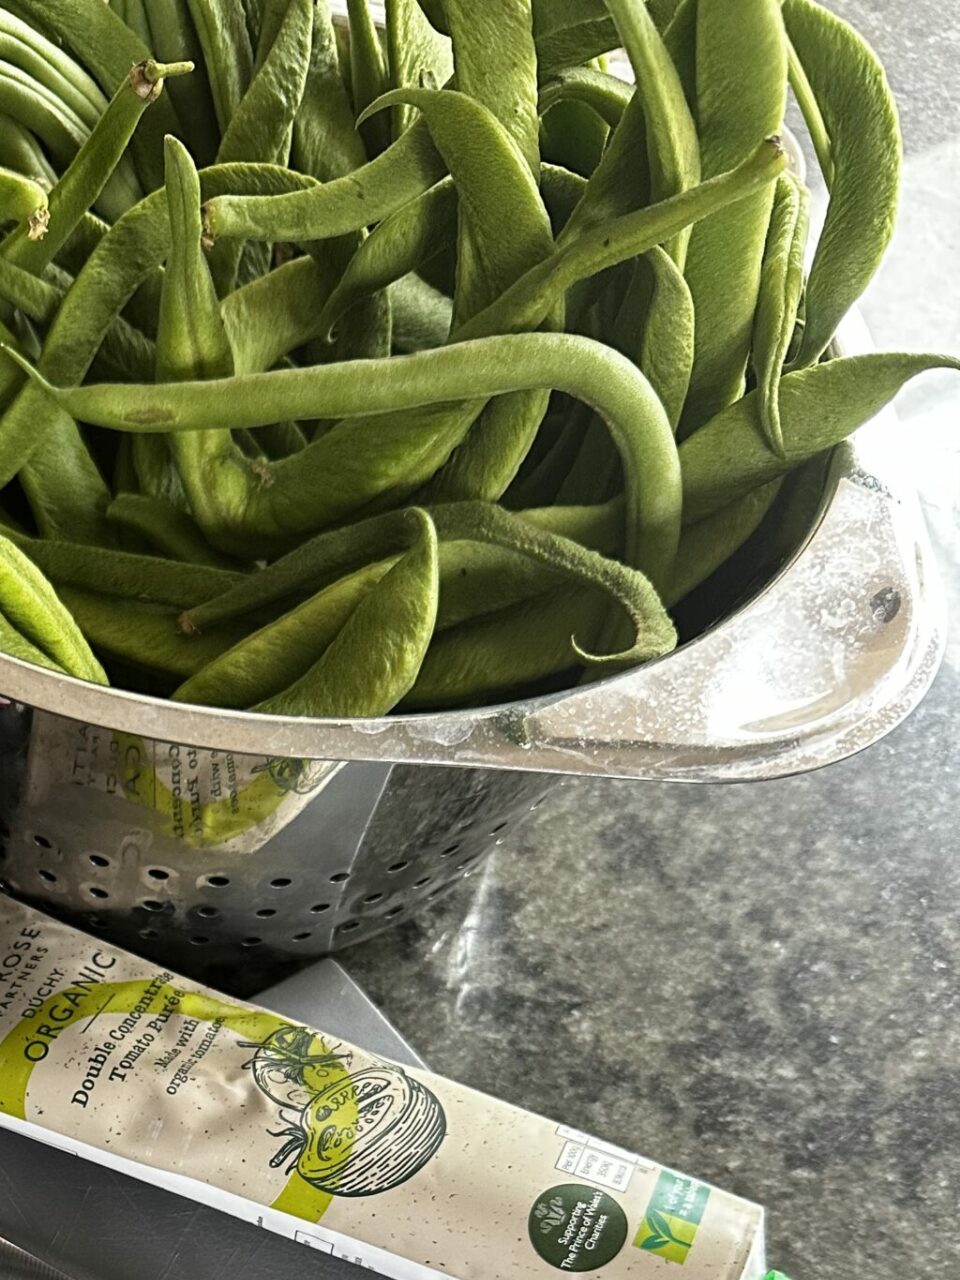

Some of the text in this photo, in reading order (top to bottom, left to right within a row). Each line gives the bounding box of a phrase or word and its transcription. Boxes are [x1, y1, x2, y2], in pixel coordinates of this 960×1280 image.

[22, 967, 65, 1019] DUCHY
[24, 951, 117, 1062] ORGANIC
[108, 989, 186, 1083] Tomato Purée
[153, 1018, 200, 1070] Made with
[71, 1041, 115, 1108] Double
[166, 1057, 195, 1096] organic
[558, 1200, 587, 1247] Supporting
[560, 1249, 576, 1270] The
[569, 1224, 587, 1253] Prince
[583, 1212, 593, 1227] of
[584, 1214, 609, 1250] Charities
